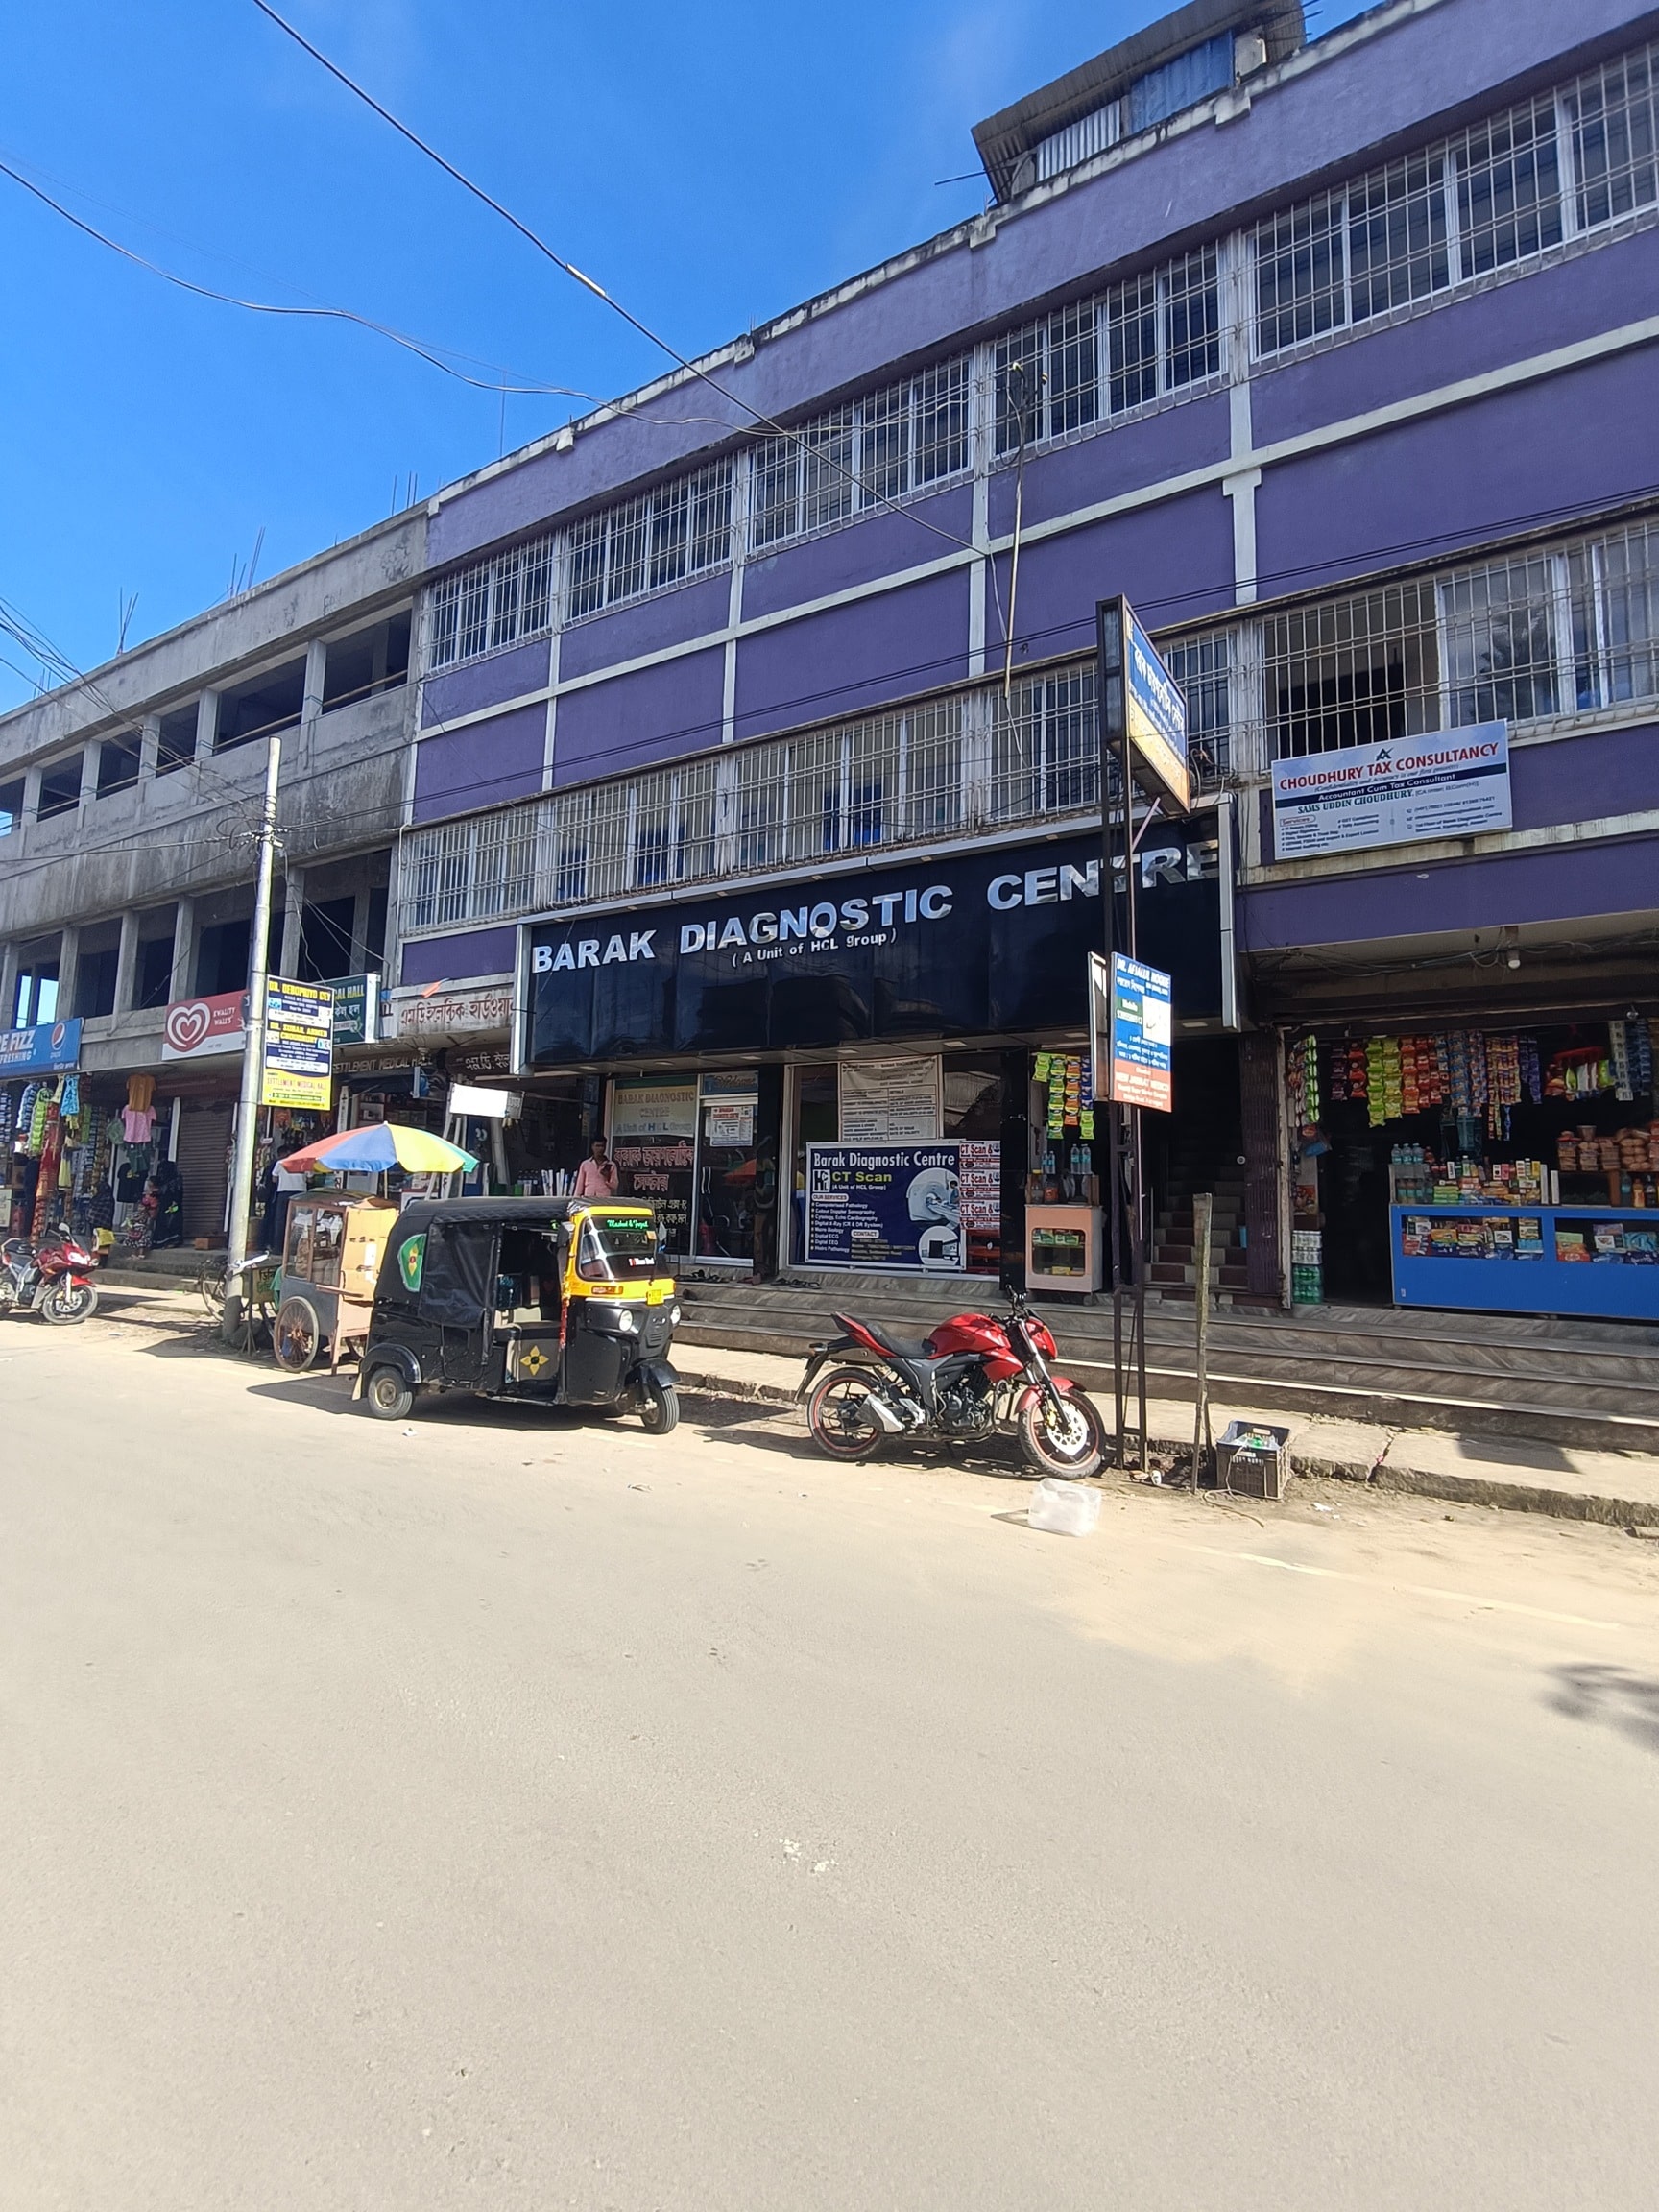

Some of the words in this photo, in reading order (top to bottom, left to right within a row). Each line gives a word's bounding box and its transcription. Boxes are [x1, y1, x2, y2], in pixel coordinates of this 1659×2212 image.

[1280, 766, 1363, 790] CHOUDHURY
[1367, 761, 1392, 777] TAX
[1395, 742, 1499, 771] CONSULTANCY
[1318, 788, 1365, 801] Accountant
[1367, 784, 1388, 793] Cum
[1407, 773, 1455, 786] Consultant
[1298, 804, 1320, 814] SAMS
[1323, 799, 1352, 811] UDDIN
[532, 929, 658, 974] BARAK
[680, 884, 953, 955] DIAGNOSTIC
[987, 838, 1219, 912] CENTRE
[757, 948, 783, 962] Unit
[789, 943, 805, 956] of
[810, 937, 838, 953] HCL
[347, 984, 364, 999] HALL
[10, 1028, 36, 1052] FIZZ
[332, 1058, 377, 1074] SETTLEMENT
[378, 1055, 411, 1070] MEDICAL
[617, 1094, 644, 1105] BARAK
[645, 1090, 695, 1104] DIAGNOSTIC
[971, 1143, 986, 1154] Scan
[814, 1152, 846, 1167] Barak
[849, 1151, 910, 1171] Diagnostic
[913, 1151, 955, 1166] Centre
[831, 1171, 852, 1182] CT
[855, 1171, 892, 1183] Scan
[971, 1173, 986, 1184] Scan
[971, 1203, 986, 1214] Scan
